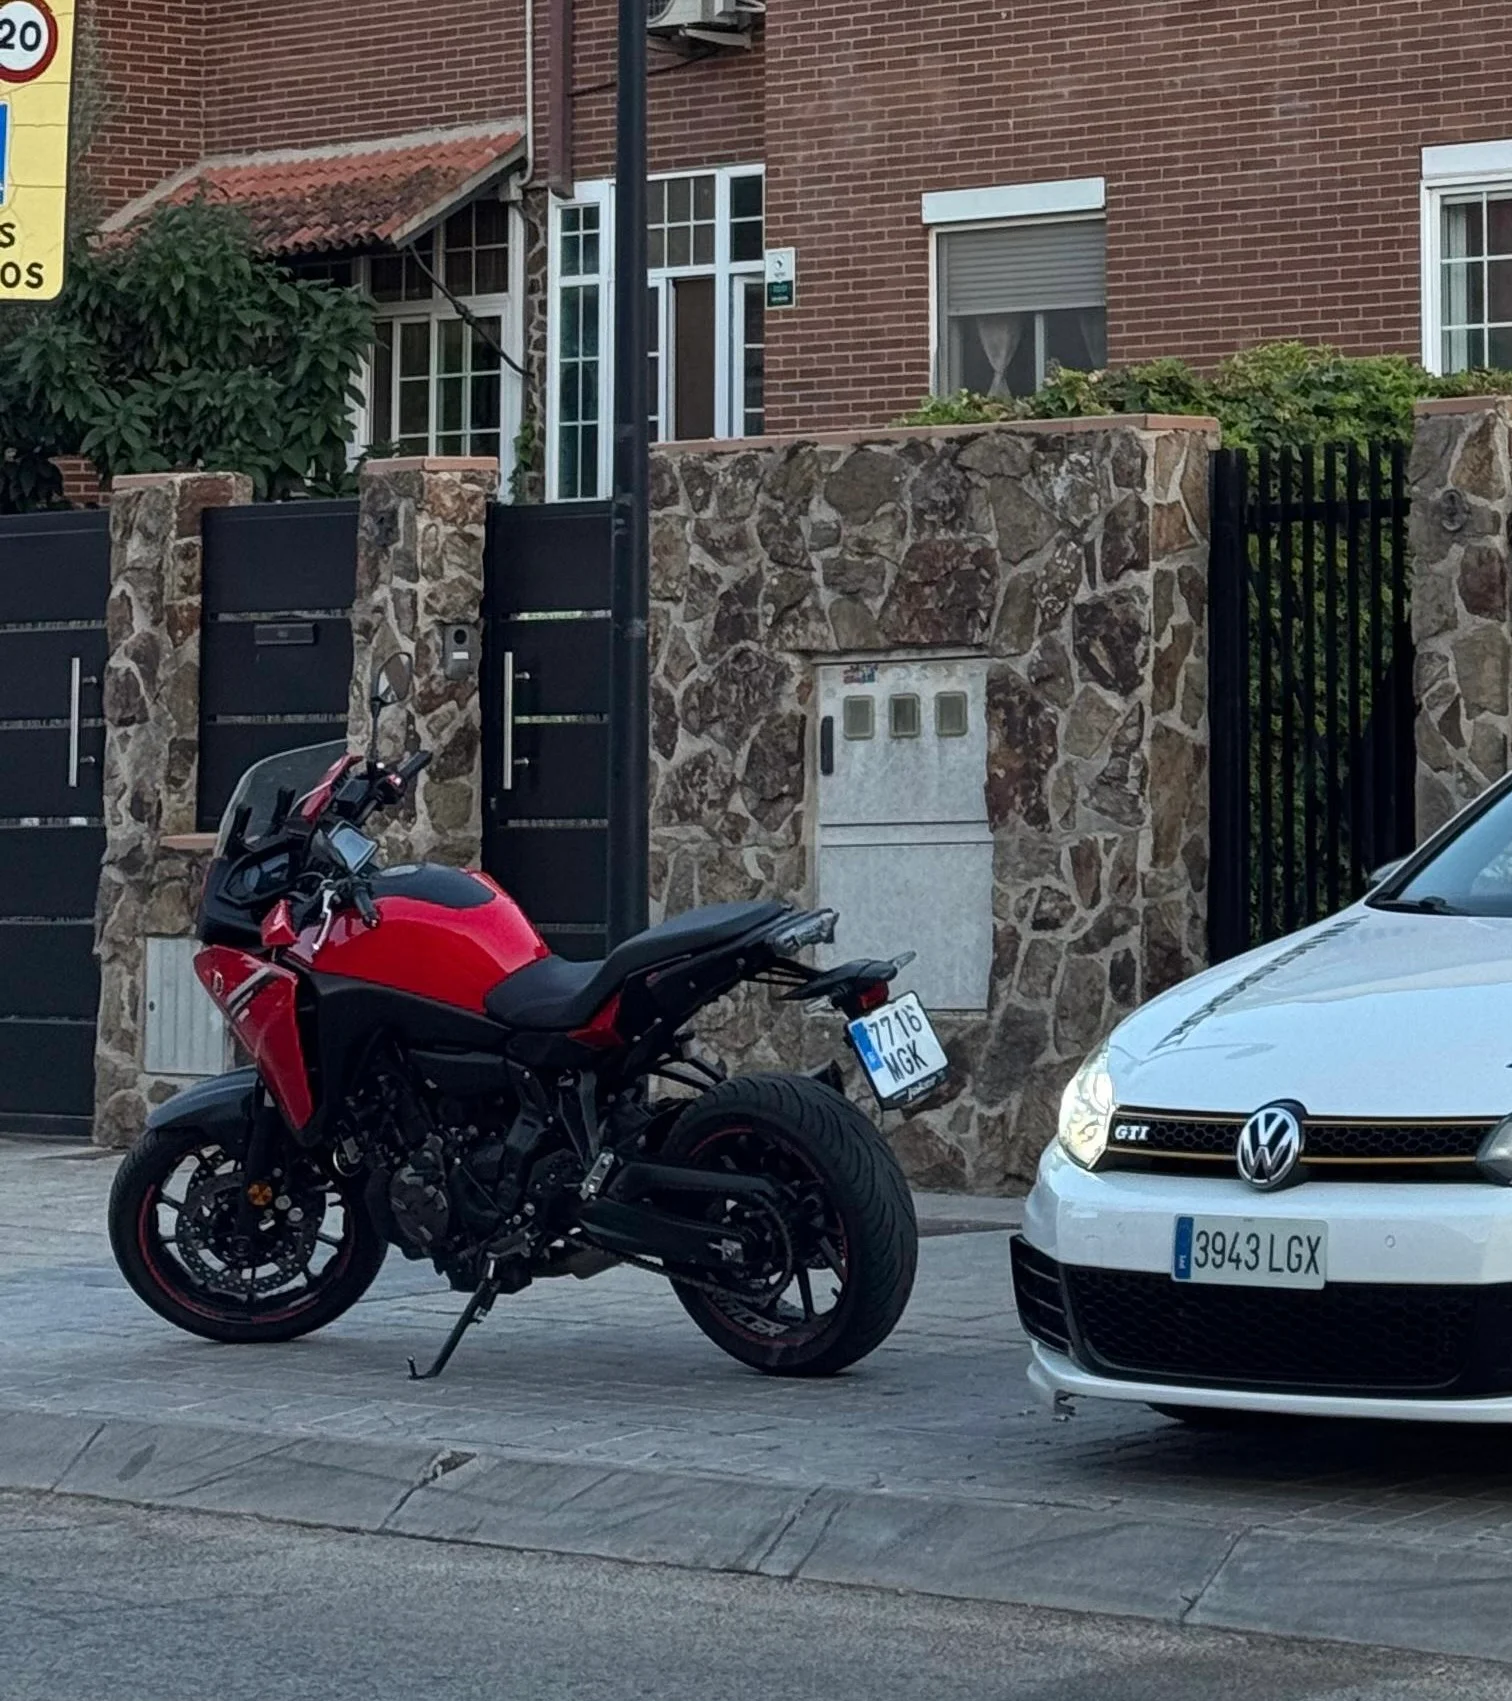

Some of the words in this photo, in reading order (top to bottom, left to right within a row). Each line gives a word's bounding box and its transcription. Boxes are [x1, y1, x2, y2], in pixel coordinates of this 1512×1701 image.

[0, 18, 42, 51] 20
[868, 1004, 922, 1053] 7716
[883, 1040, 928, 1083] MGK
[1114, 1125, 1150, 1141] GTI
[1194, 1230, 1261, 1271] 3943
[1268, 1233, 1322, 1275] LGX
